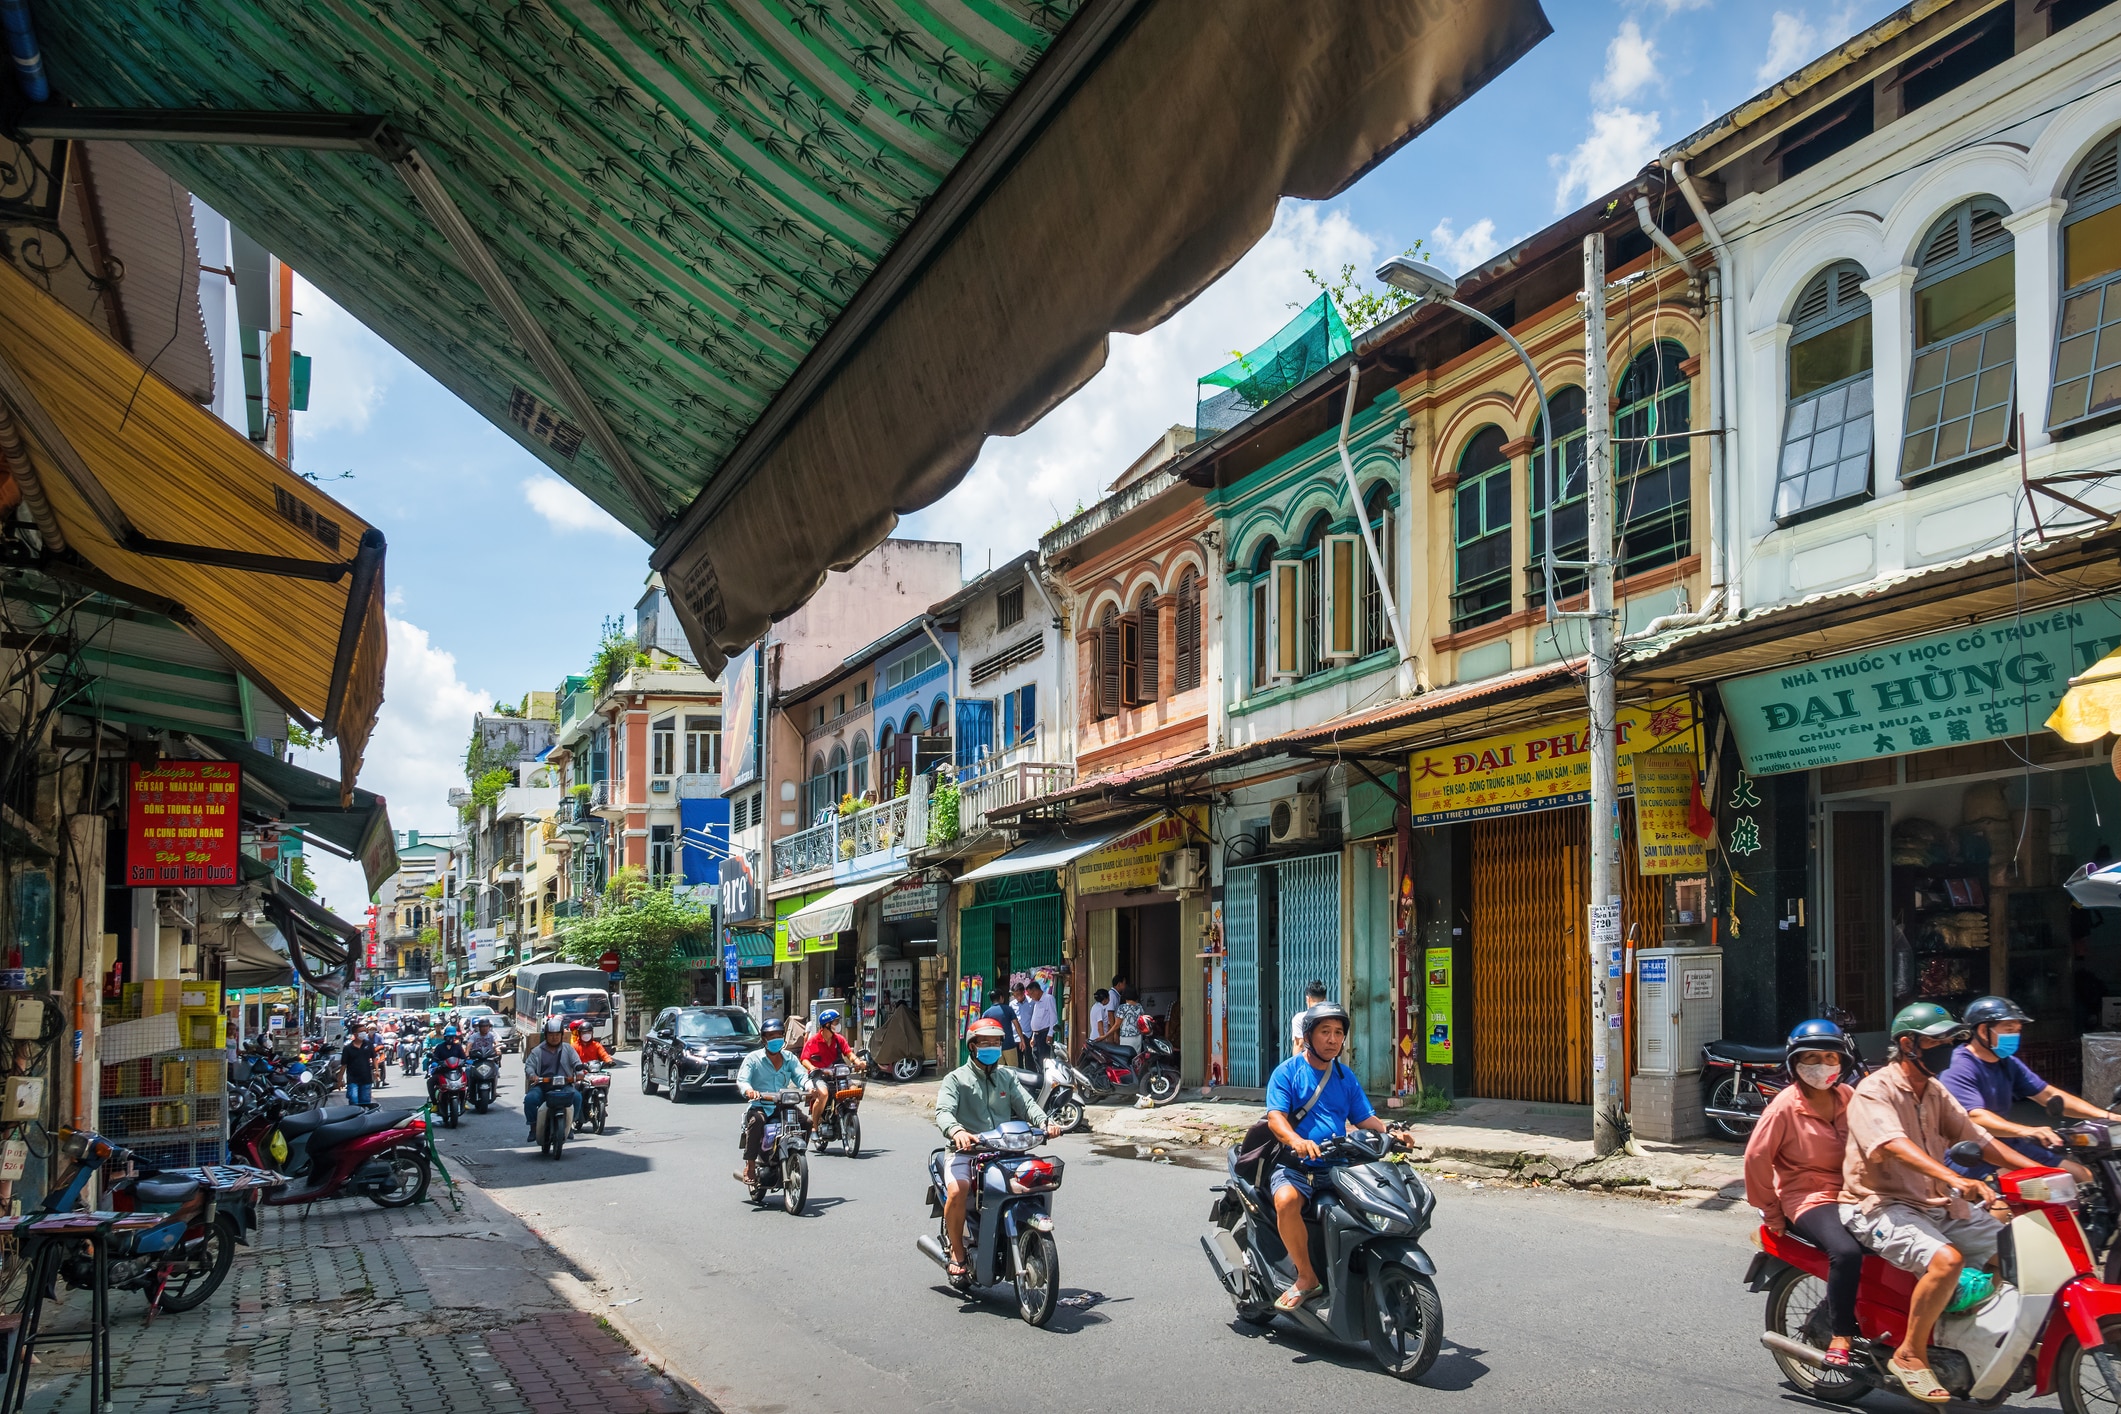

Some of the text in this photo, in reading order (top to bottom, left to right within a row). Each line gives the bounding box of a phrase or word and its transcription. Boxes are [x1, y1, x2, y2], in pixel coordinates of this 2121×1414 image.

[1781, 612, 2084, 689] NHÀ THUỐC Y HỌC CỔ TRUYỀN
[1760, 689, 1861, 732] ĐẠI
[1871, 651, 2056, 713] HÙNG
[1643, 705, 1692, 738] 發
[1798, 721, 1875, 743] CHUYÊN
[1879, 714, 1924, 730] MUA
[1928, 702, 1972, 721] BÁN
[1978, 693, 2042, 712] DƯỢC
[1452, 744, 1517, 775] ĐẠI
[1617, 754, 1632, 767] CUN
[1750, 742, 1842, 763] 113 TRIỆU QUANG PHỤC
[1758, 762, 1791, 774] PHƯỜNG
[1807, 755, 1831, 766] QUẬN
[1415, 756, 1449, 783] 大
[1573, 761, 1588, 776] LINH
[1432, 813, 1443, 821] 111
[1445, 810, 1470, 819] TRIỆU
[1472, 805, 1502, 816] QUANG
[1504, 802, 1528, 812] PHỤC
[1538, 797, 1557, 806] P.11
[1567, 793, 1584, 802] Q.5
[1648, 799, 1663, 807] CUNG
[144, 828, 154, 838] AN
[156, 828, 176, 838] CUNG
[1158, 819, 1183, 843] AN
[719, 869, 748, 915] are
[367, 905, 377, 968] HOTEL
[1596, 918, 1612, 929] 720
